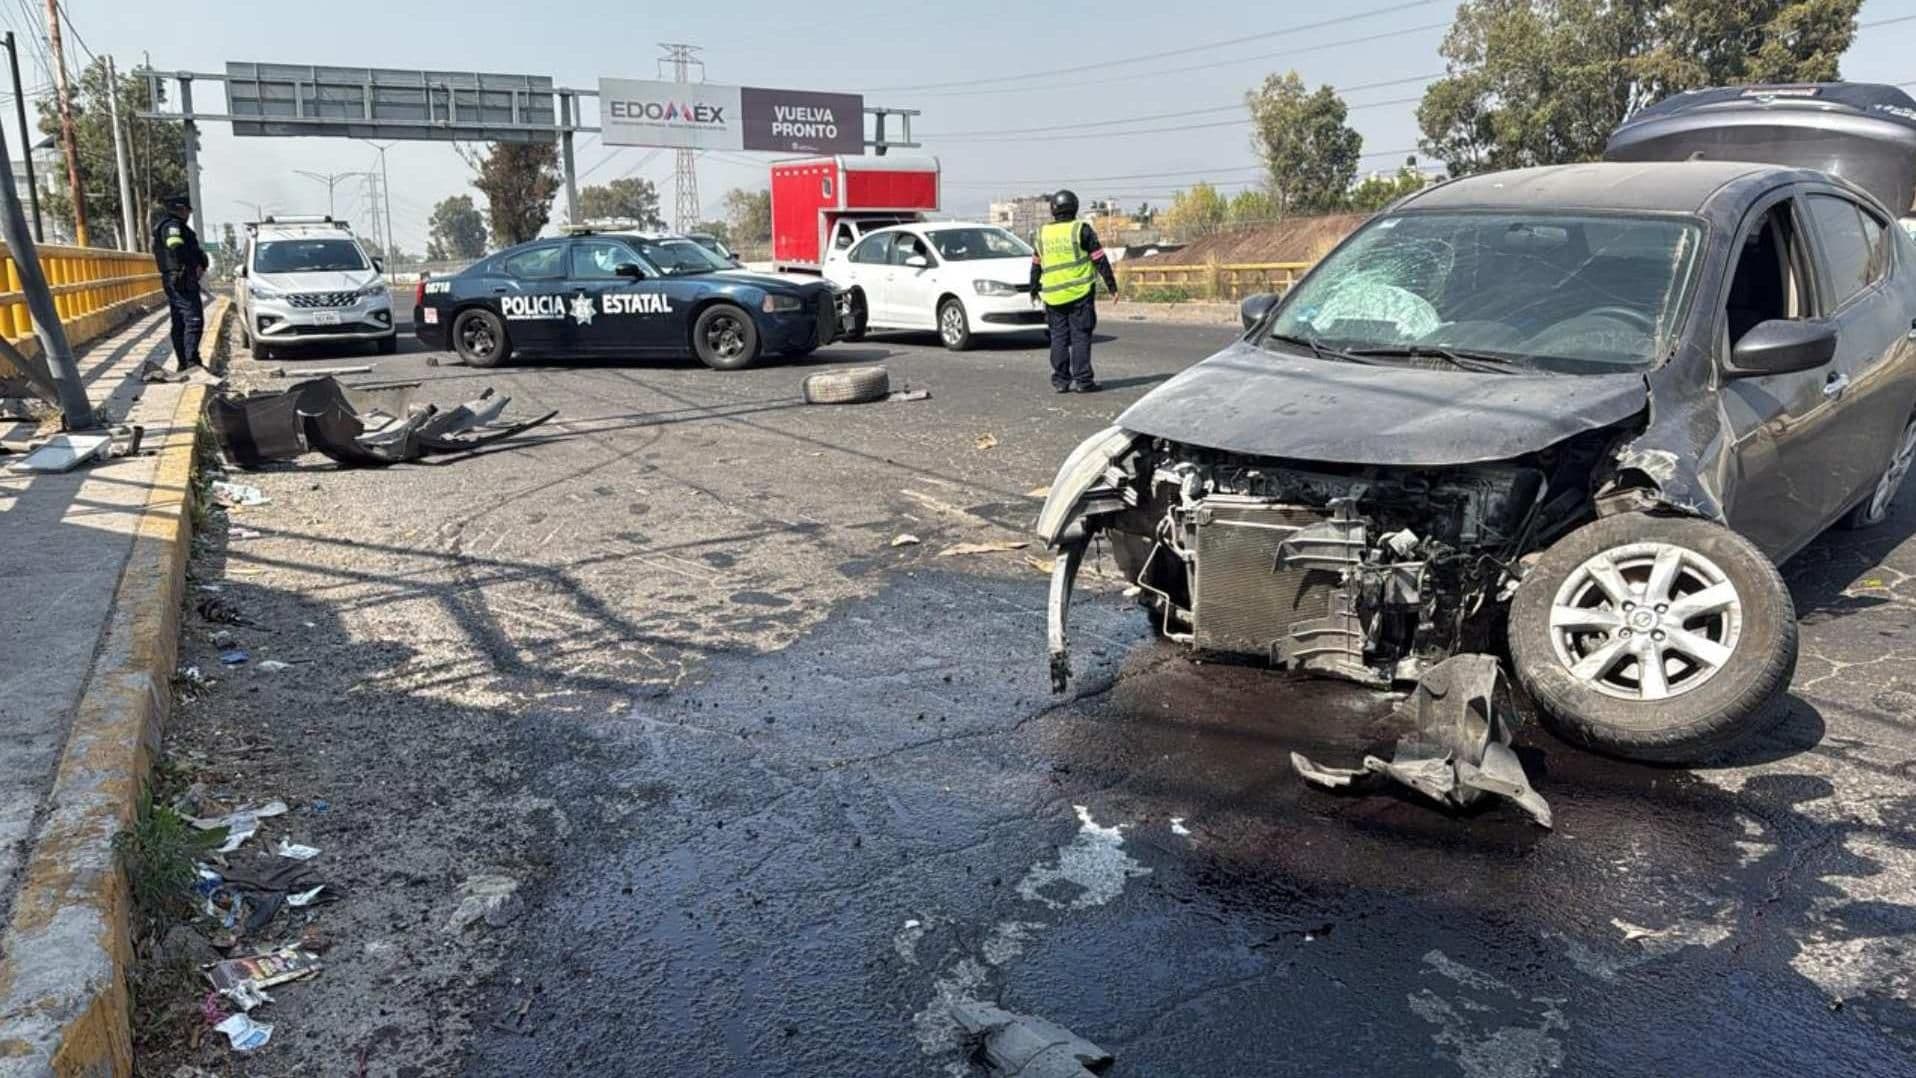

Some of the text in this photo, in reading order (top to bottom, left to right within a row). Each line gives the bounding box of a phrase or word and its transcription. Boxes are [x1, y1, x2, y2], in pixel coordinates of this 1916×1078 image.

[774, 106, 833, 122] VUELVA
[772, 122, 838, 138] PRONTO
[501, 293, 673, 315] POLICIA ESTATAL
